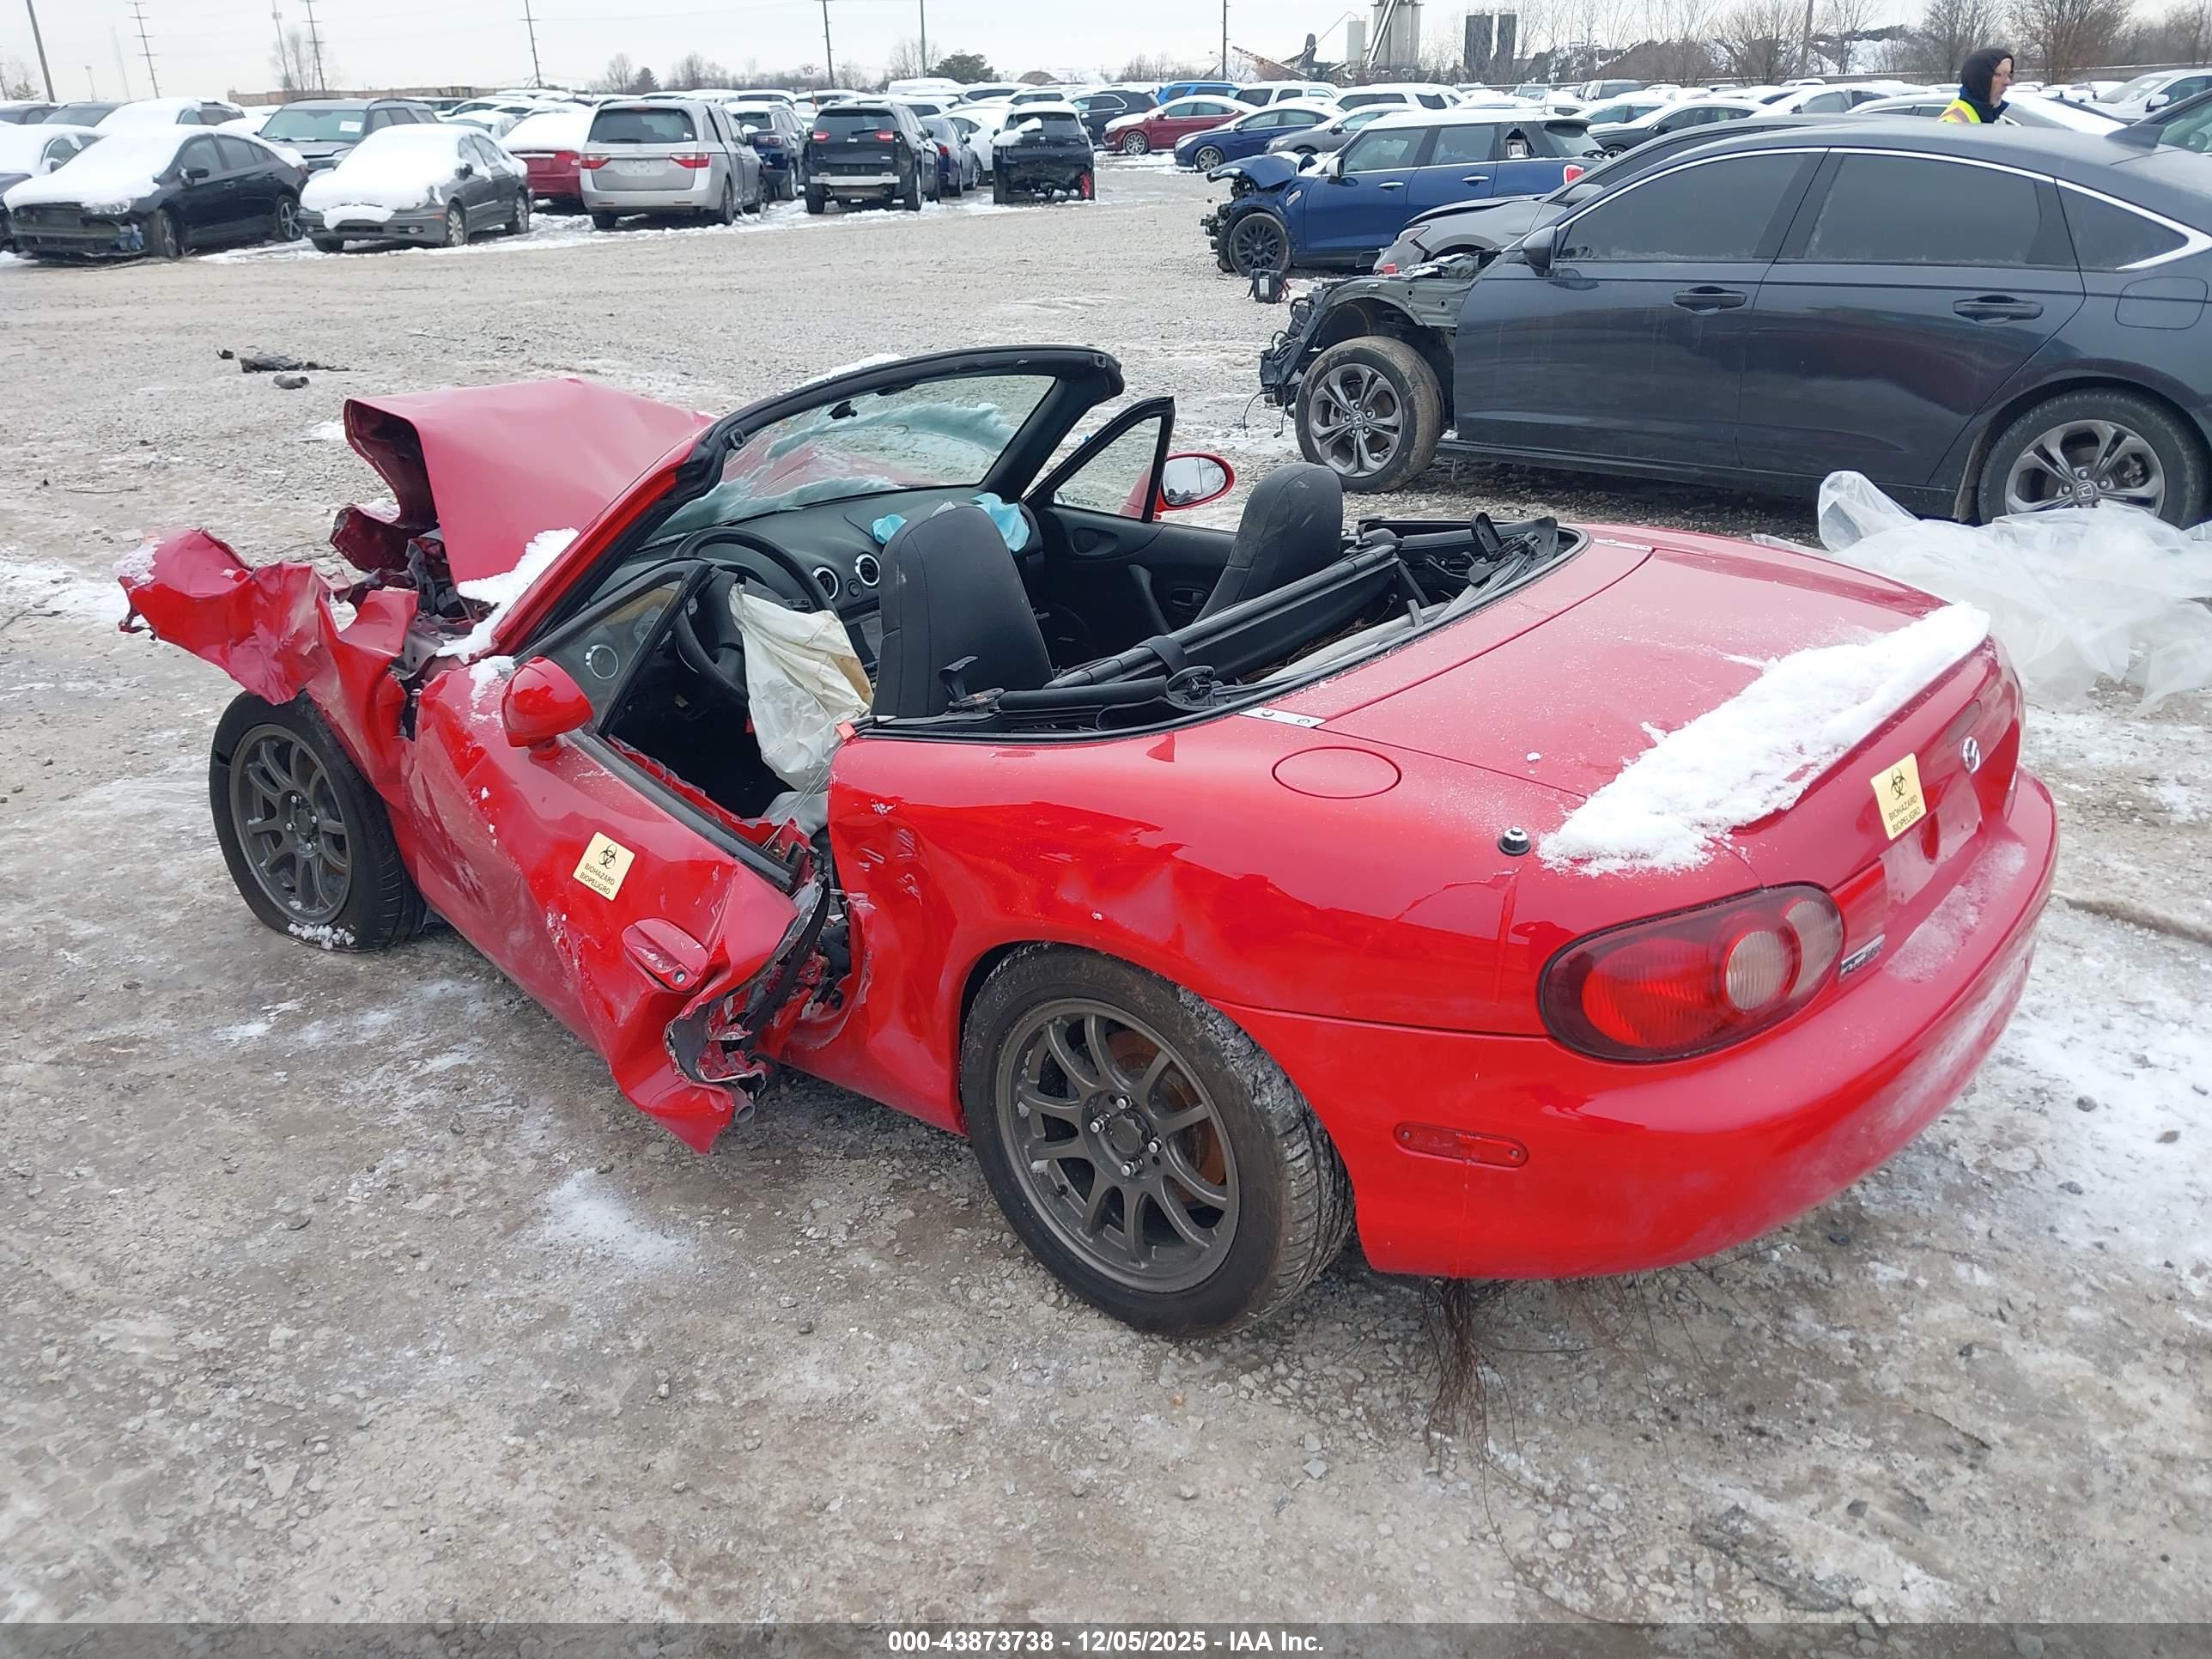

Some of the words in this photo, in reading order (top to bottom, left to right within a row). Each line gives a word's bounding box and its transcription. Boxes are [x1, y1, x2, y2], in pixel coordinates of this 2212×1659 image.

[802, 65, 814, 76] 10
[1888, 794, 1917, 822] BIOHAZARD
[1892, 806, 1921, 833] BIOPELIGRO
[579, 872, 611, 895] BIOPELIGRO
[584, 862, 616, 885] BIOHAZARD
